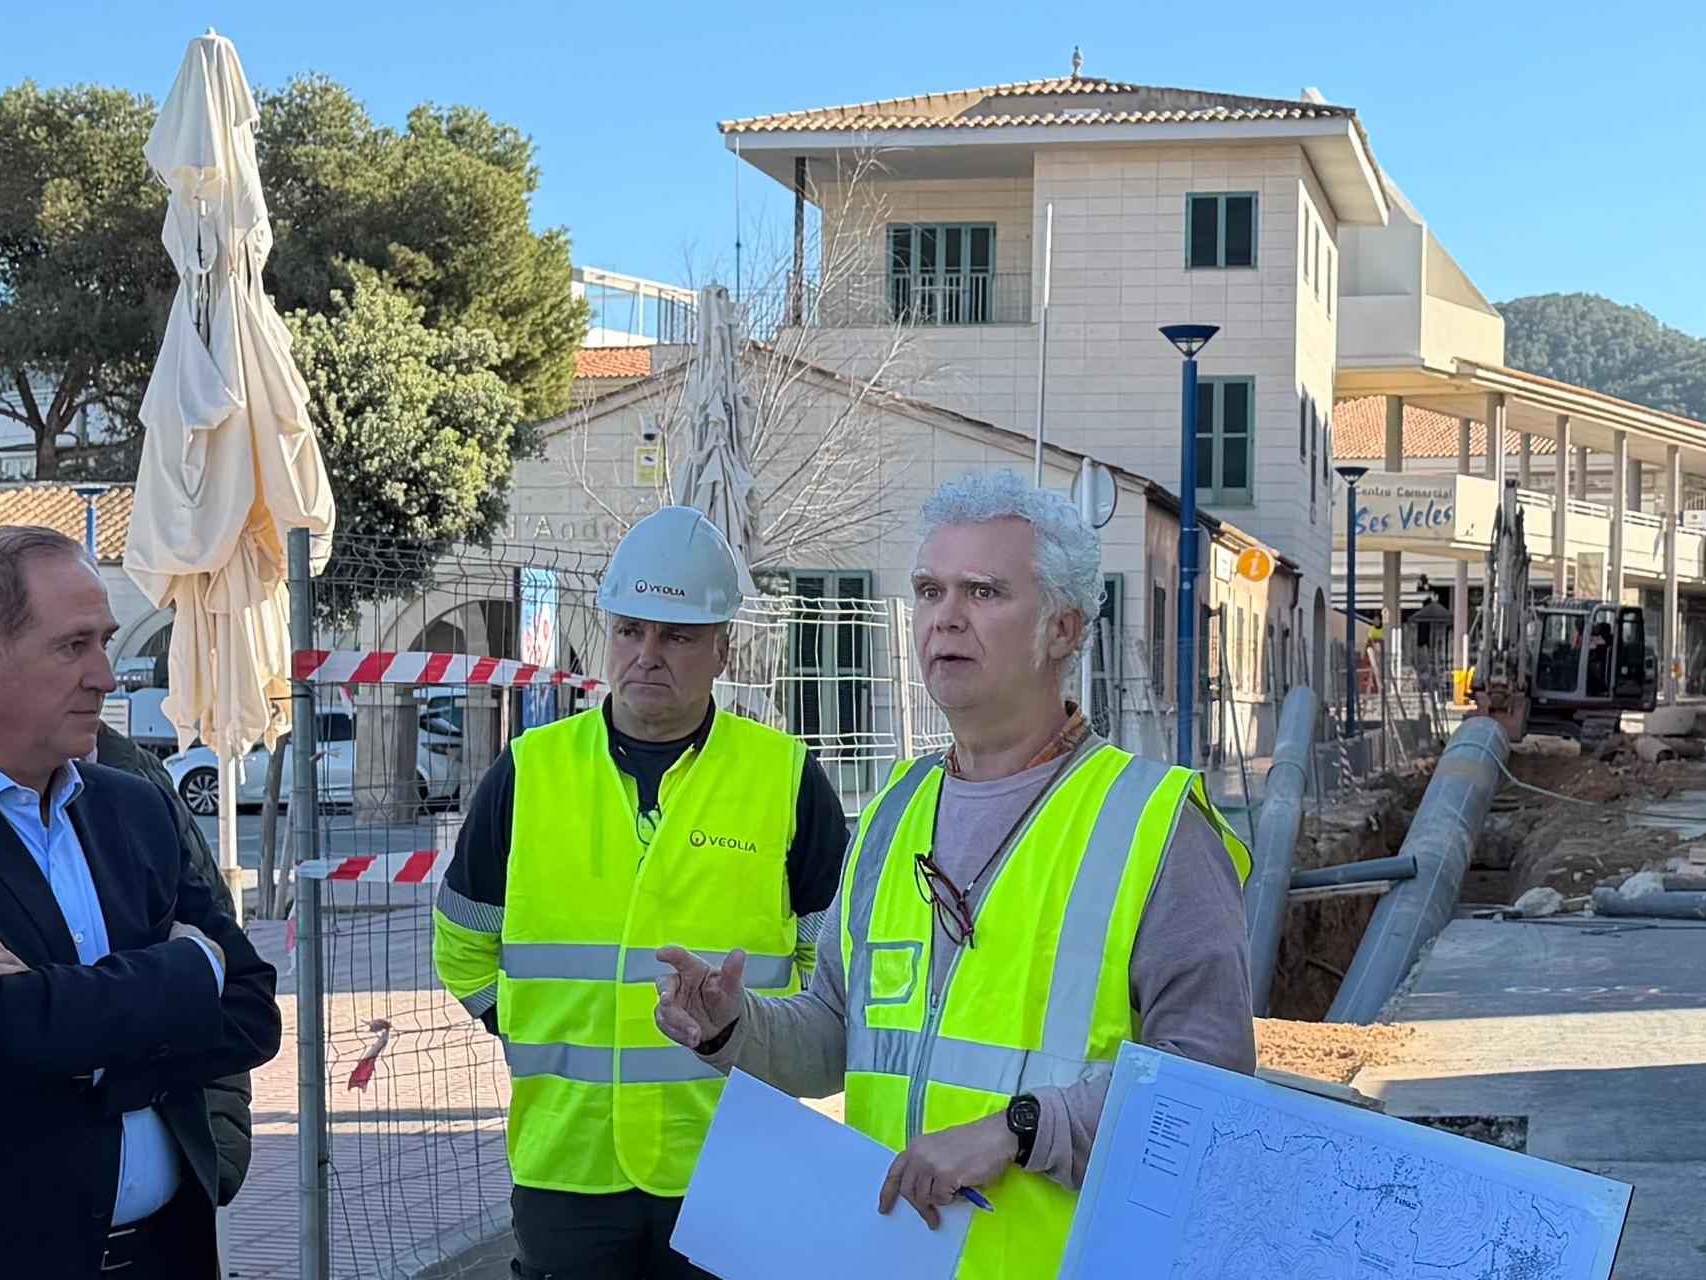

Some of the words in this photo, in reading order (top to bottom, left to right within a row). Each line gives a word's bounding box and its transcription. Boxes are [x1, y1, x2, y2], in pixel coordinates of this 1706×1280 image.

[1354, 486, 1391, 497] Centro
[1397, 487, 1453, 499] Comercial
[1354, 506, 1391, 535] Ses
[1399, 499, 1453, 531] Veles
[709, 835, 757, 853] VEOLIA
